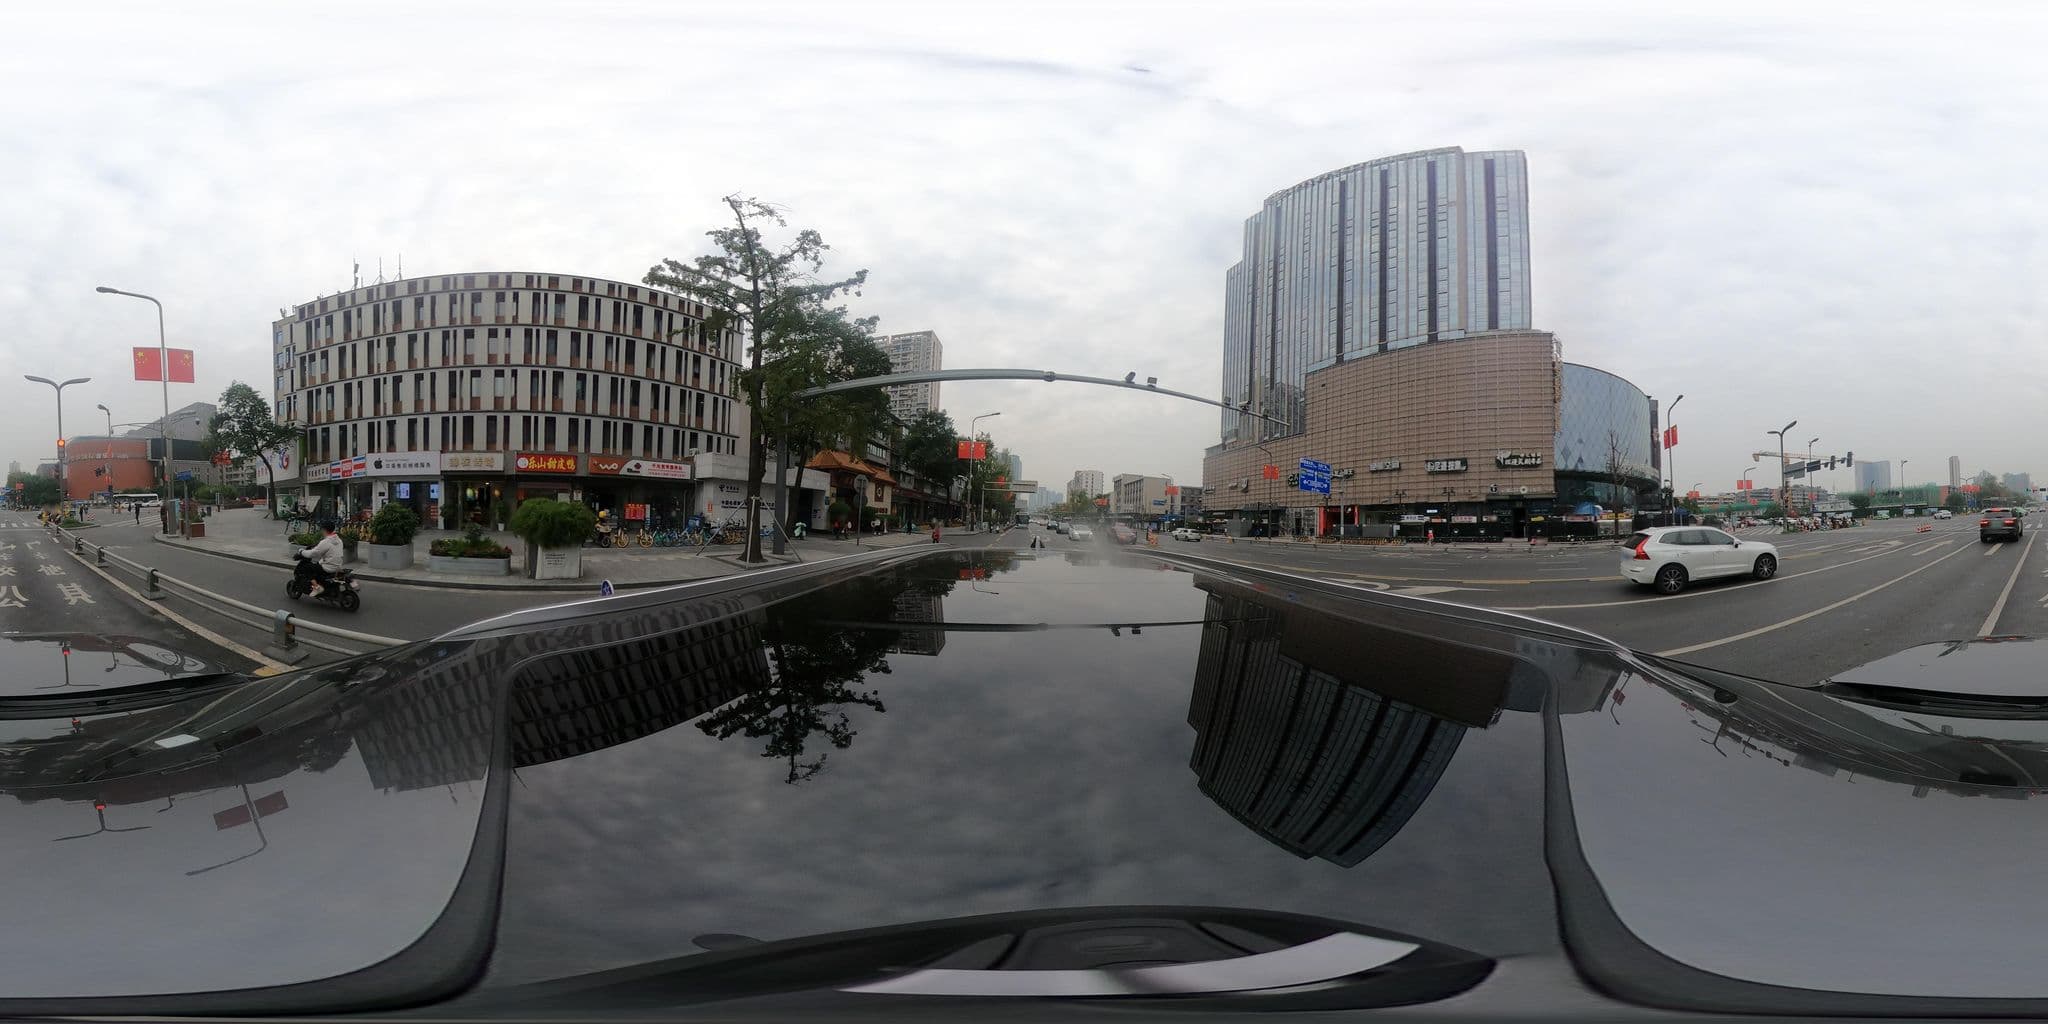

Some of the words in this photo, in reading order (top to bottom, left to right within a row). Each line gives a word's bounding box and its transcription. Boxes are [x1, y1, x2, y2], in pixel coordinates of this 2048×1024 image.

[527, 457, 576, 471] 乐山甜皮鸭
